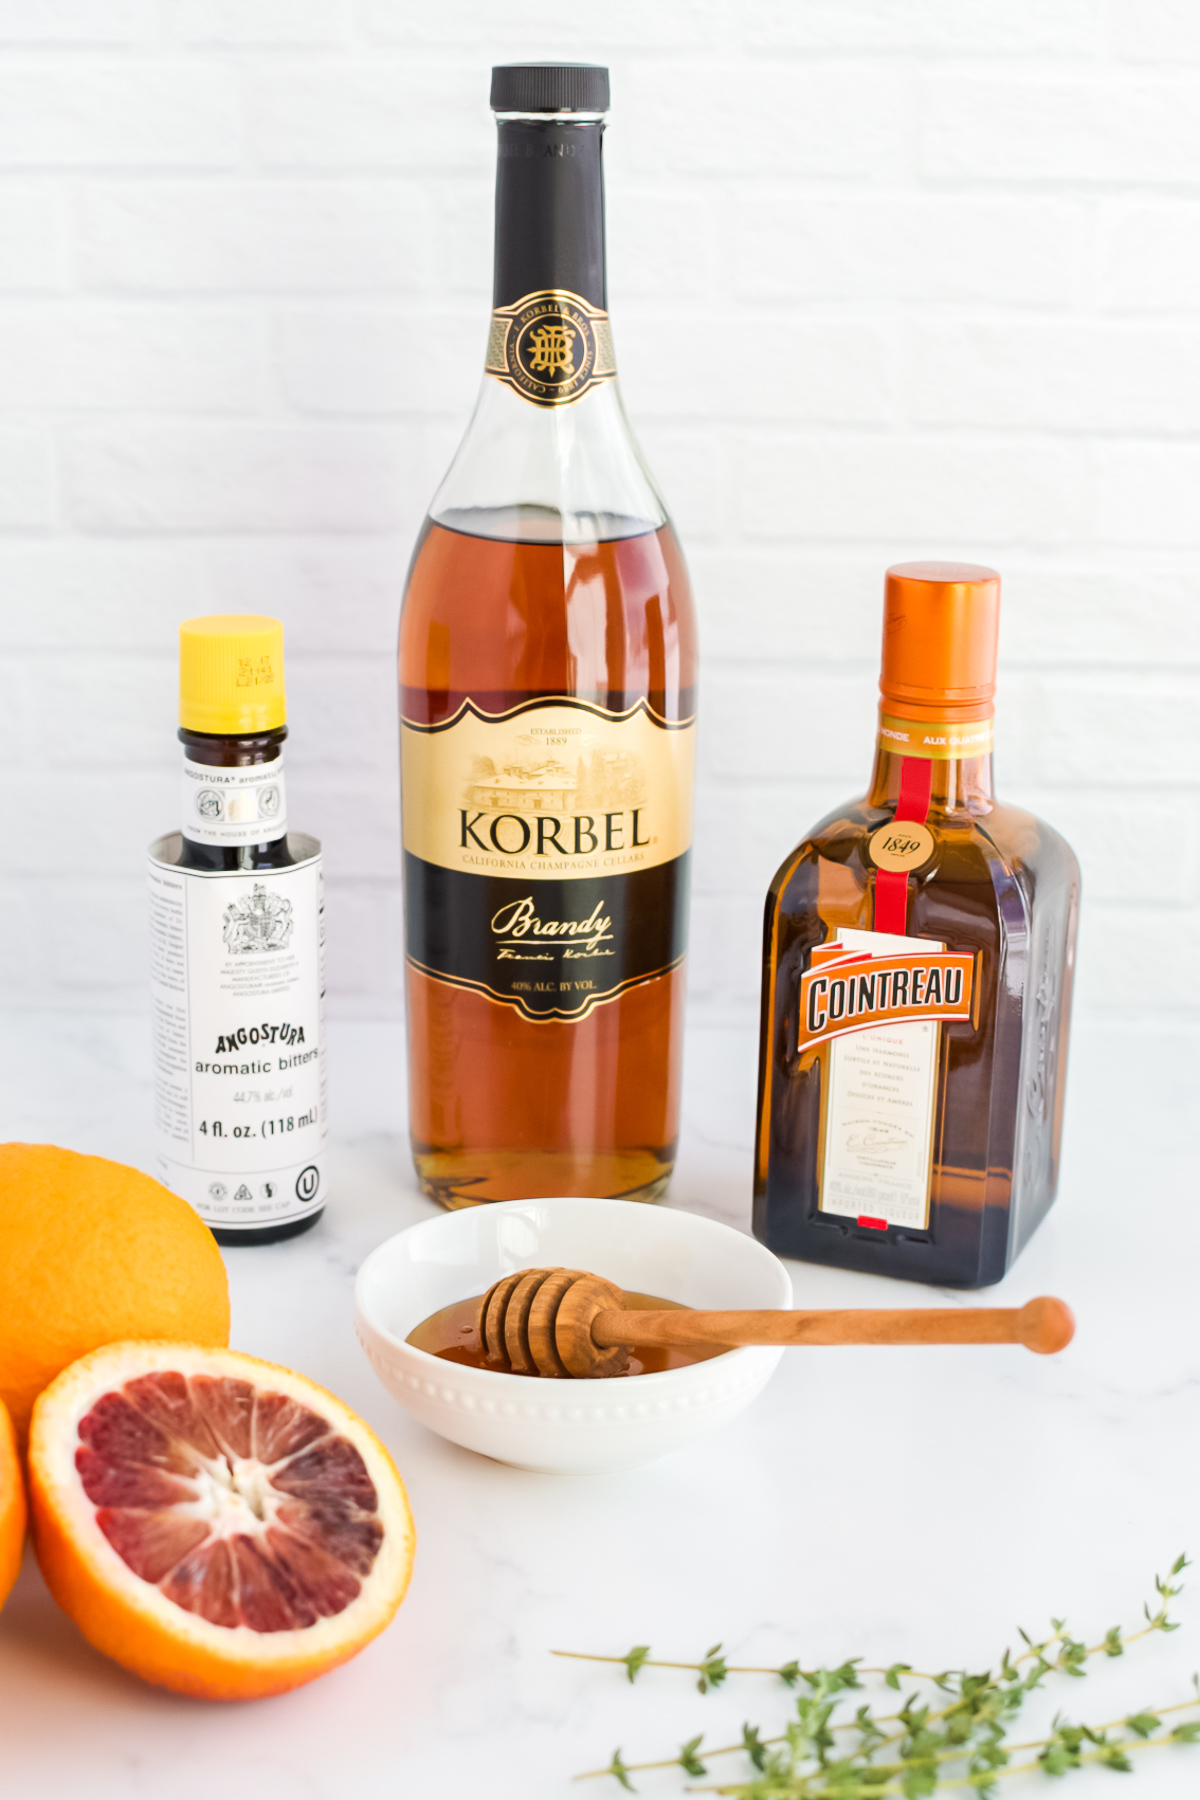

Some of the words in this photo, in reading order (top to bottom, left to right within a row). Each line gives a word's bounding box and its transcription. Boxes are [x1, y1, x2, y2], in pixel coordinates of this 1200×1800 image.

[520, 304, 560, 323] KORBEL
[530, 727, 582, 735] ESTABLISHED
[923, 736, 947, 745] AUX
[546, 737, 568, 746] 1889
[220, 830, 247, 839] HOUSE
[458, 807, 651, 856] KORBEL
[881, 837, 921, 854] 1849
[462, 854, 526, 870] CALIFORNIA
[530, 858, 600, 871] CHAMPAGNE
[603, 852, 645, 868] CELLARS
[491, 896, 613, 951] Brandy
[511, 981, 532, 991] 40%
[533, 981, 557, 992] ALC.
[560, 981, 573, 991] BY
[807, 968, 963, 1032] COINTREAU
[215, 1022, 305, 1054] ANGOSTURA
[195, 1061, 271, 1075] aromatic
[278, 1047, 318, 1071] bitters
[198, 1120, 207, 1136] 4
[212, 1120, 228, 1138] fl.
[232, 1126, 257, 1138] oz.
[261, 1116, 295, 1140] (118
